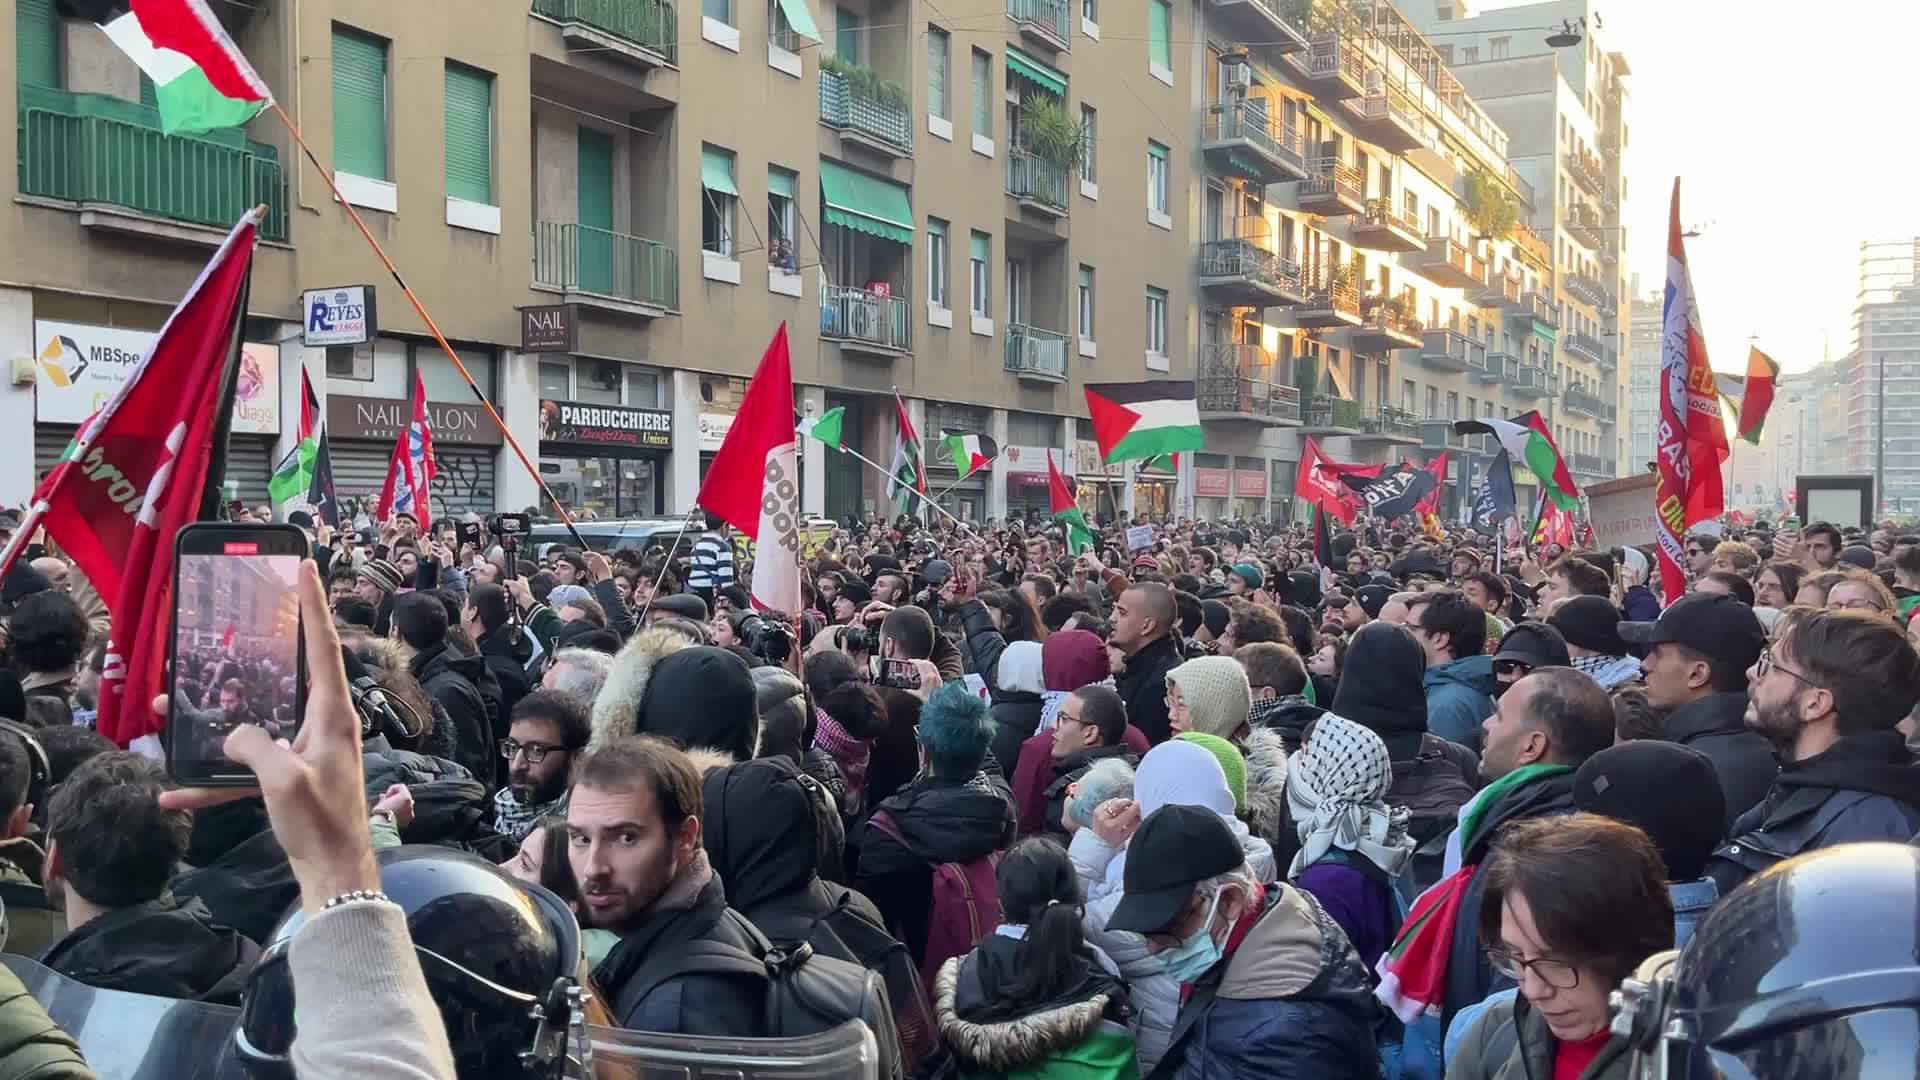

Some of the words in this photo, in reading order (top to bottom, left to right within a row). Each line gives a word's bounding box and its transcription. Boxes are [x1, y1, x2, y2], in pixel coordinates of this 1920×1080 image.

[309, 303, 363, 332] REYES
[528, 311, 565, 331] NAIL
[357, 403, 405, 427] NAIL
[561, 406, 670, 431] PARRUCCHIERE
[643, 431, 669, 445] Unisex
